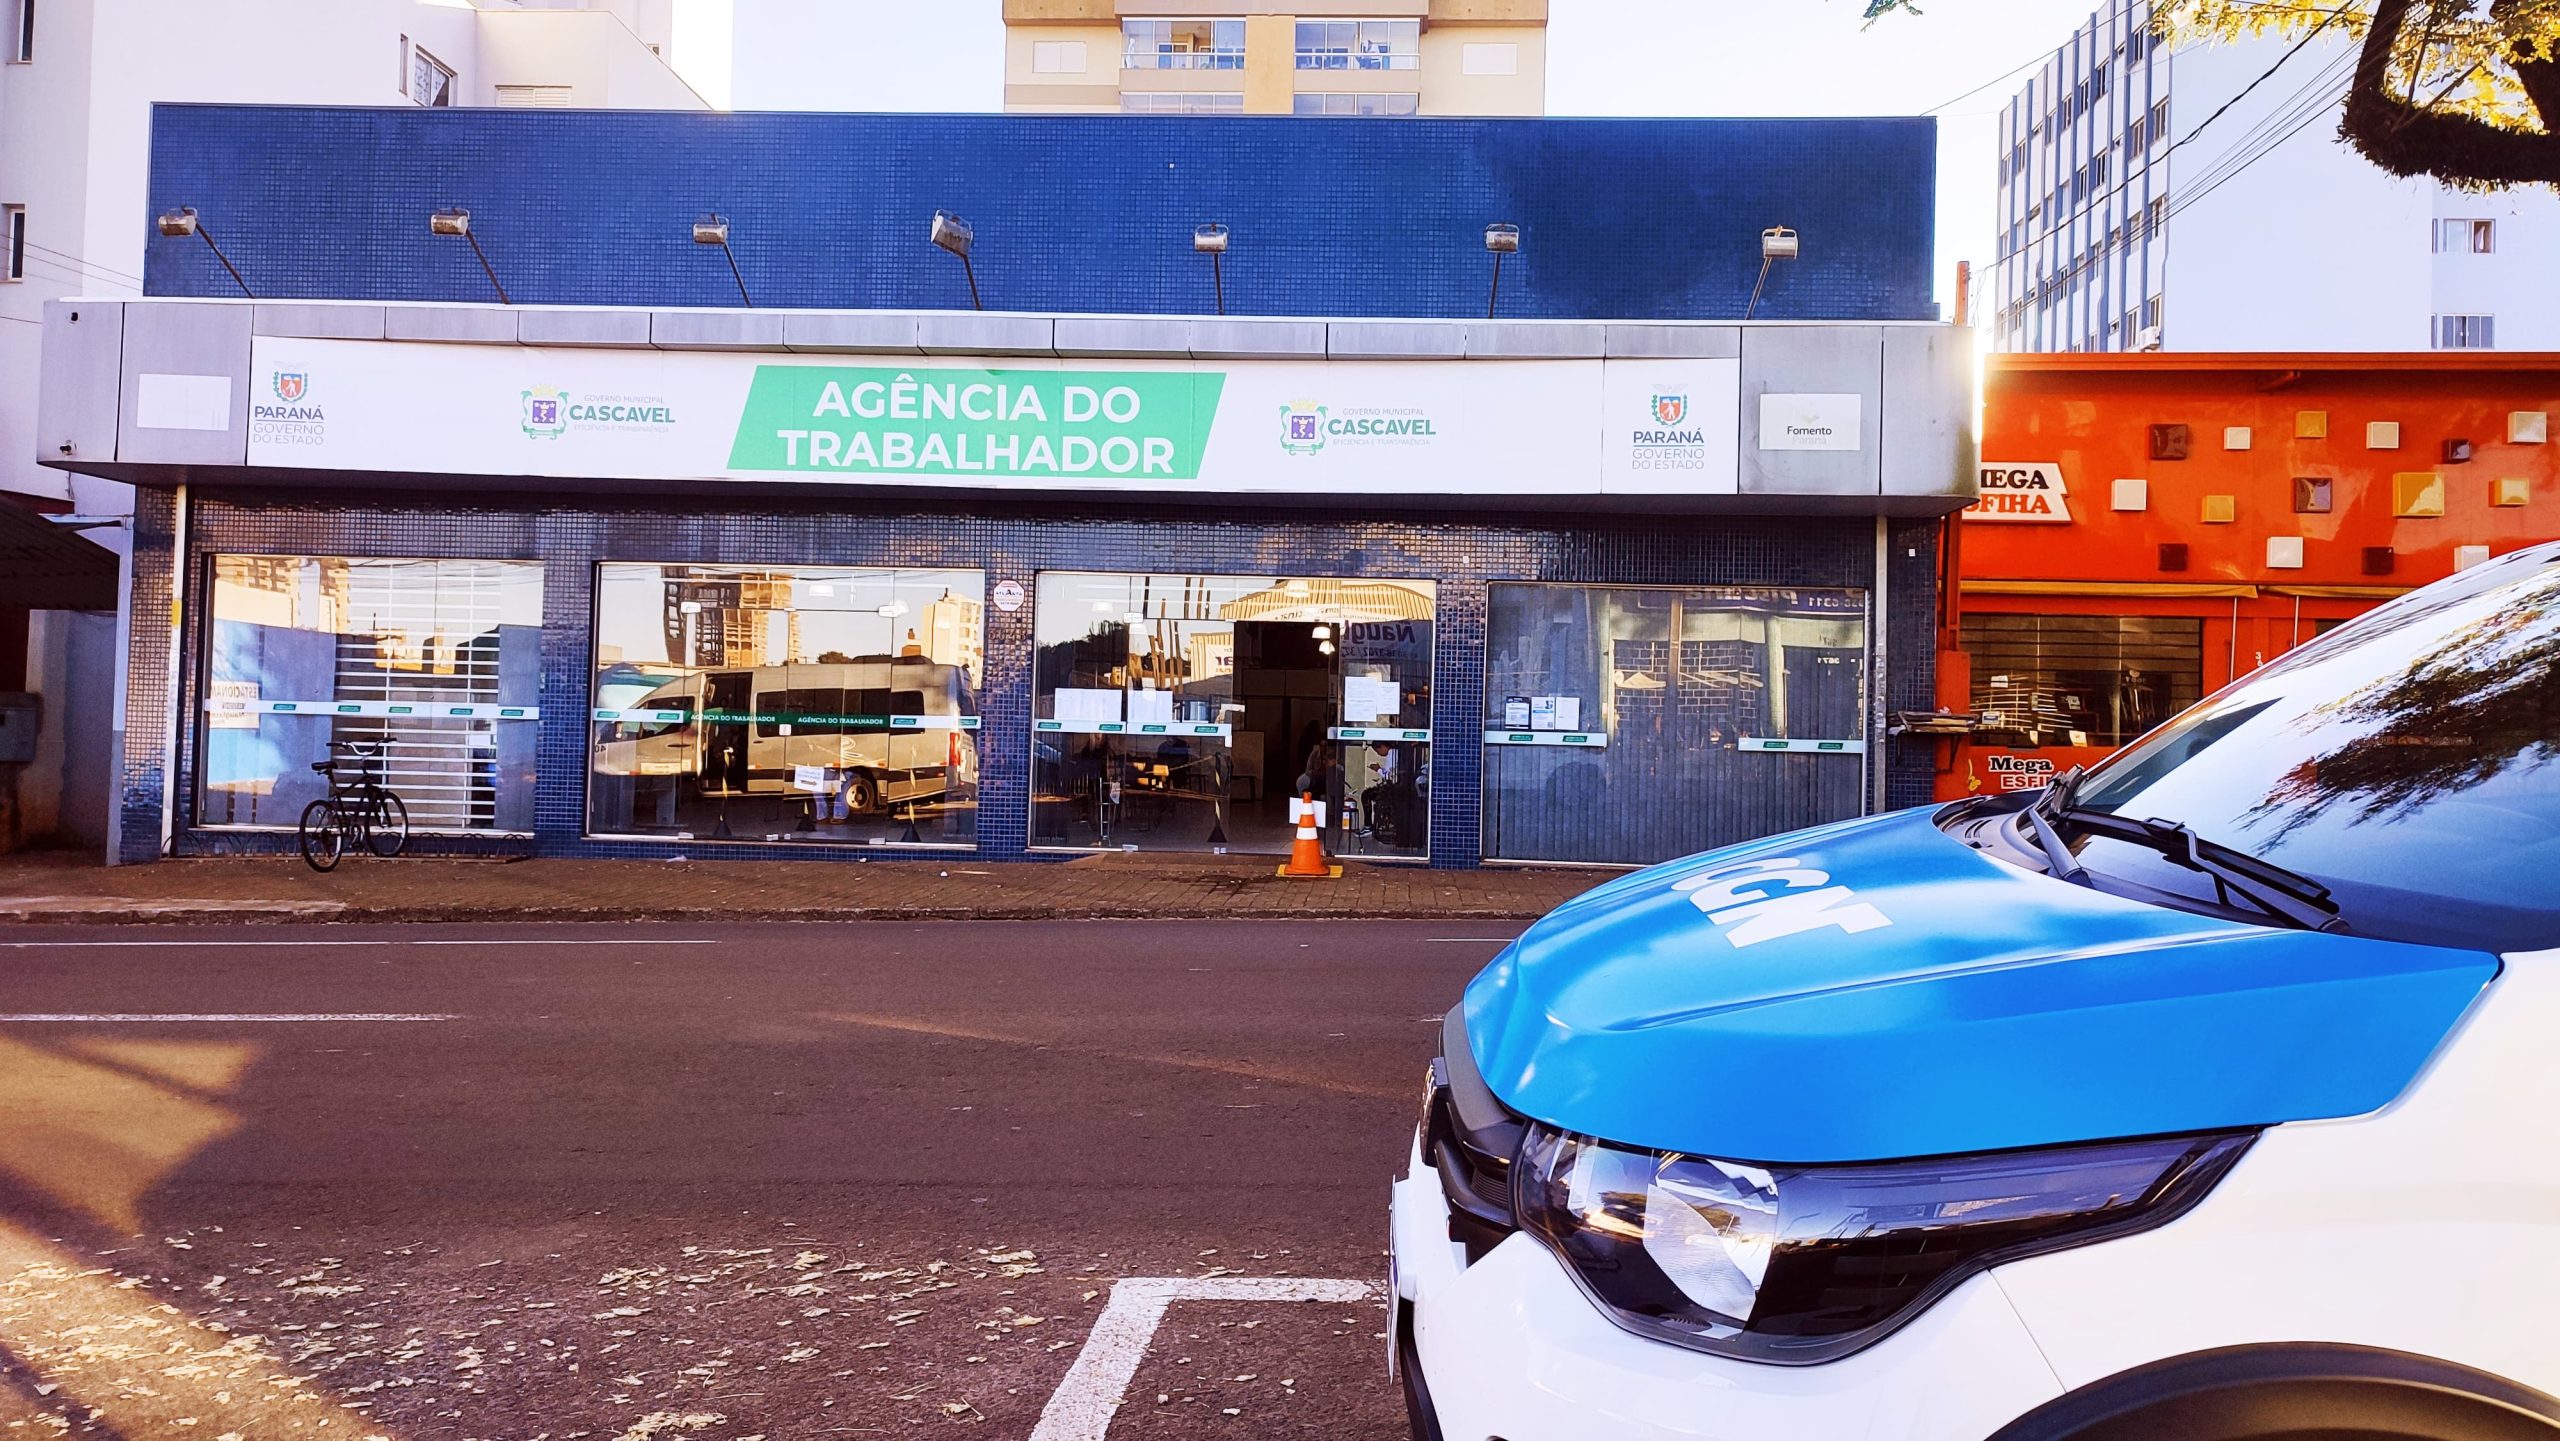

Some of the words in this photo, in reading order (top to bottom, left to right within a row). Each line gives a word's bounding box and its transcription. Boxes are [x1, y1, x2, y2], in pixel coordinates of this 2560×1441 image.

[812, 373, 1048, 422] AGÊNCIA
[1062, 385, 1141, 424] DO
[254, 404, 325, 421] PARANÁ
[569, 404, 676, 423] CASCAVEL
[1342, 408, 1381, 416] GOVERNO
[1382, 408, 1424, 416] MUNICIPAL
[253, 423, 325, 435] GOVERNO
[1327, 418, 1437, 436] CASCAVEL
[1632, 427, 1705, 444] PARANÁ
[1786, 426, 1833, 436] Fomento
[252, 433, 272, 444] DO
[275, 434, 324, 445] ESTADO
[776, 429, 1175, 475] TRABALHADOR
[1632, 448, 1705, 459] GOVERNO
[1632, 459, 1651, 470] DO
[1654, 460, 1705, 470] ESTADO
[797, 715, 827, 724] AGÊNCIA
[839, 717, 884, 725] TRABALHADOR
[1989, 757, 2053, 774] Mega
[1670, 857, 1895, 949] CGN
